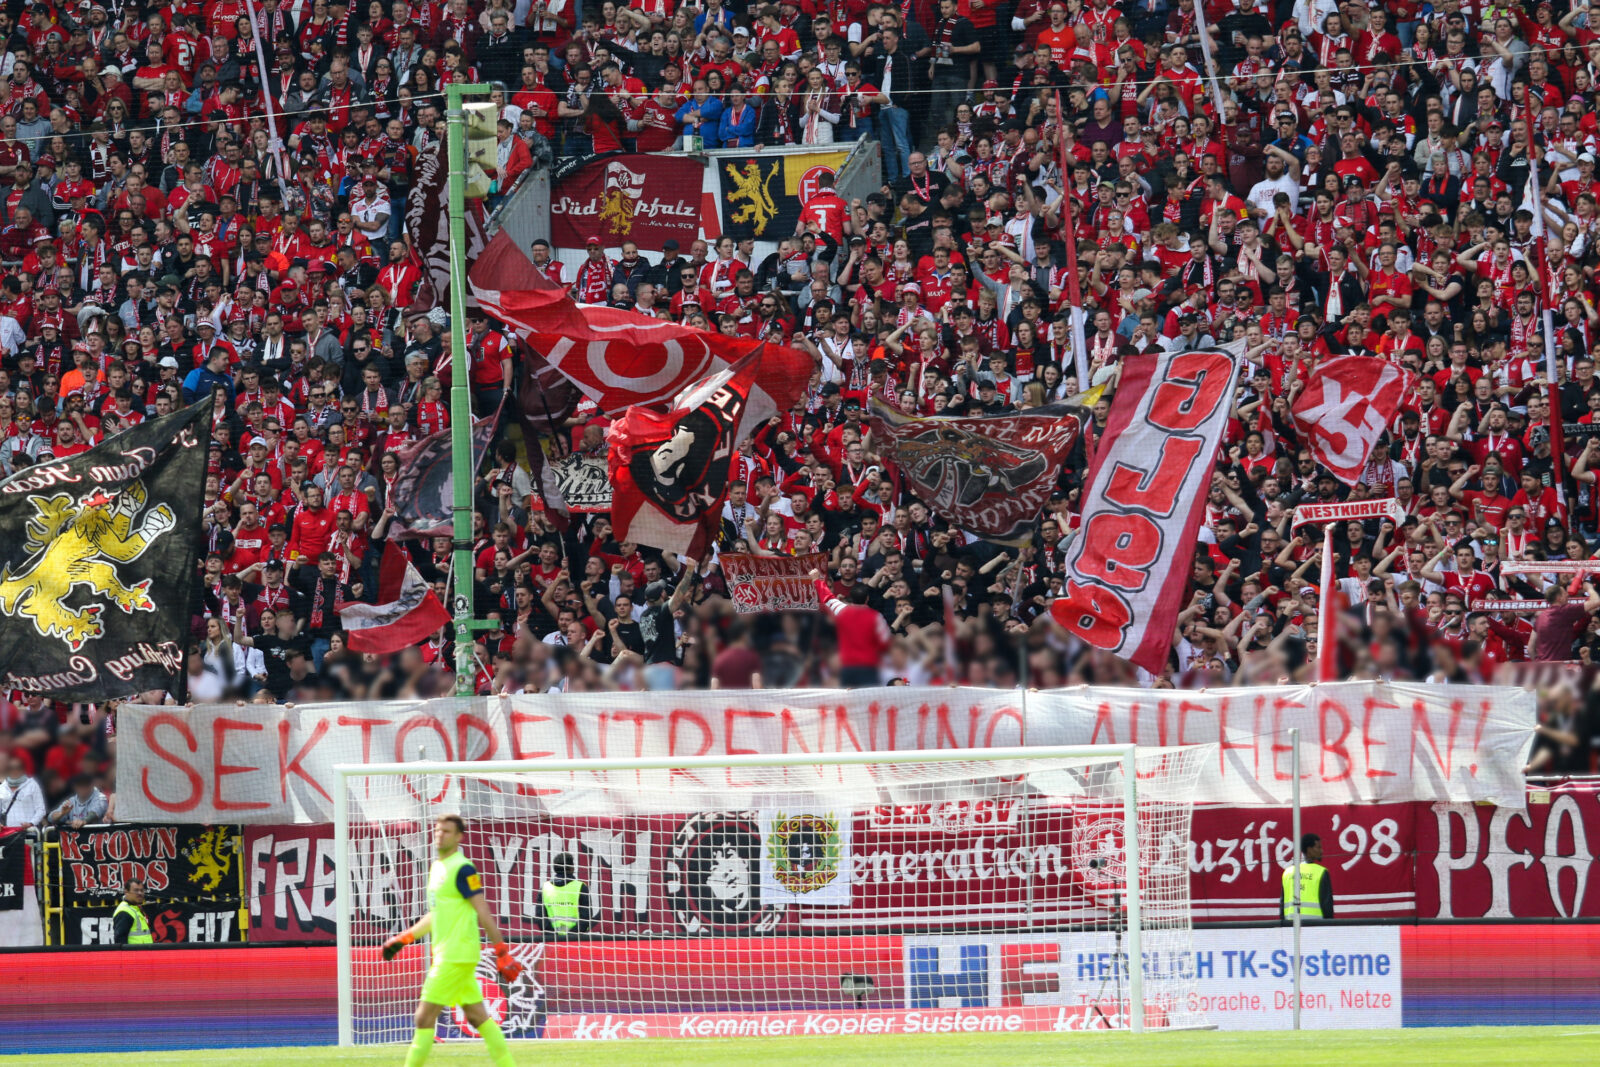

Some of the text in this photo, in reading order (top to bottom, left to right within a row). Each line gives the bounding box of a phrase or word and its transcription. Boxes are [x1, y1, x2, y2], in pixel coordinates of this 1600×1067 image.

[551, 196, 598, 216] Süd
[633, 197, 696, 217] pfalz
[1300, 501, 1388, 520] WESTKURVE
[1484, 600, 1552, 610] KAISERSLA
[59, 827, 178, 861] K-TOWN
[1429, 794, 1598, 919] PFA
[71, 860, 170, 893] REDS
[1221, 948, 1392, 984] TK-Systeme
[1339, 988, 1392, 1009] Netze
[573, 1014, 649, 1039] kks
[679, 1011, 1023, 1037] Kemmler Kopier Systeme
